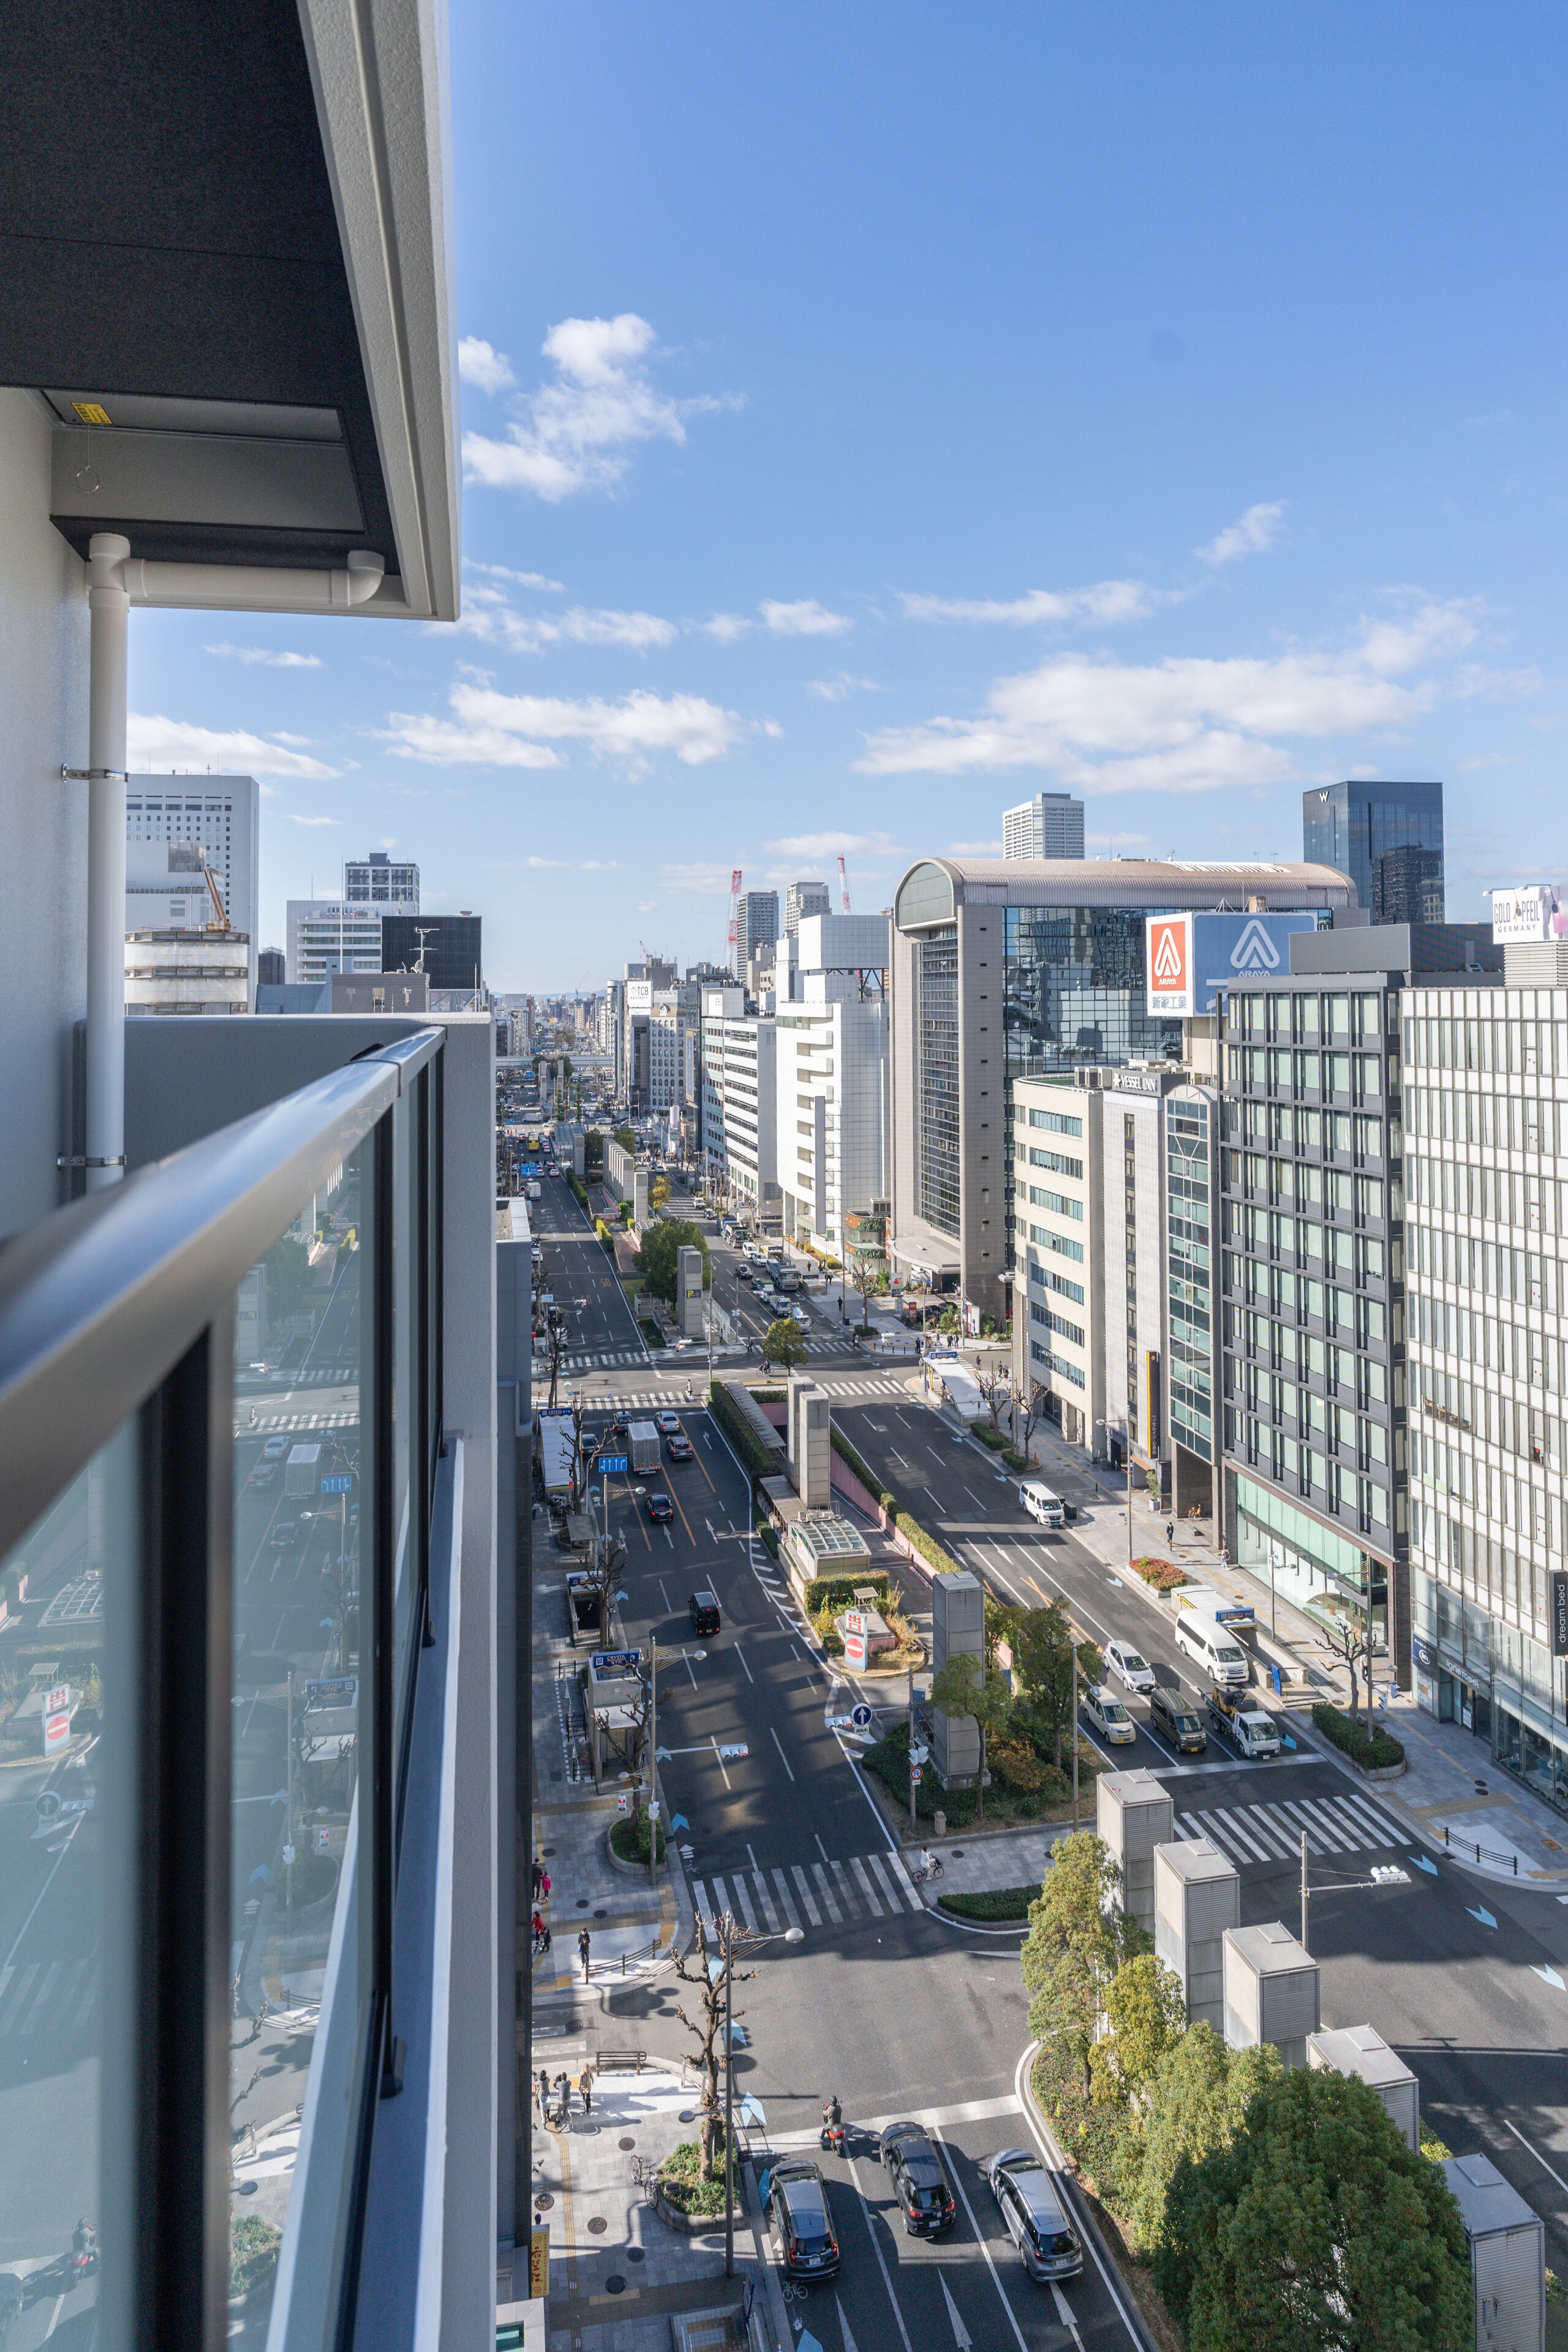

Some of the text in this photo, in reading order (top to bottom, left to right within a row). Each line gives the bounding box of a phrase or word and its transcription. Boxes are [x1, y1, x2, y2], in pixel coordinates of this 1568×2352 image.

[1494, 900, 1540, 924] GOLD PFEIL
[637, 987, 649, 995] TCB
[1152, 996, 1187, 1009] 新家工業
[1121, 1075, 1155, 1091] VESSEL INN
[1557, 1585, 1566, 1606] bed
[1446, 1659, 1461, 1676] ligne
[1462, 1672, 1480, 1689] roset
